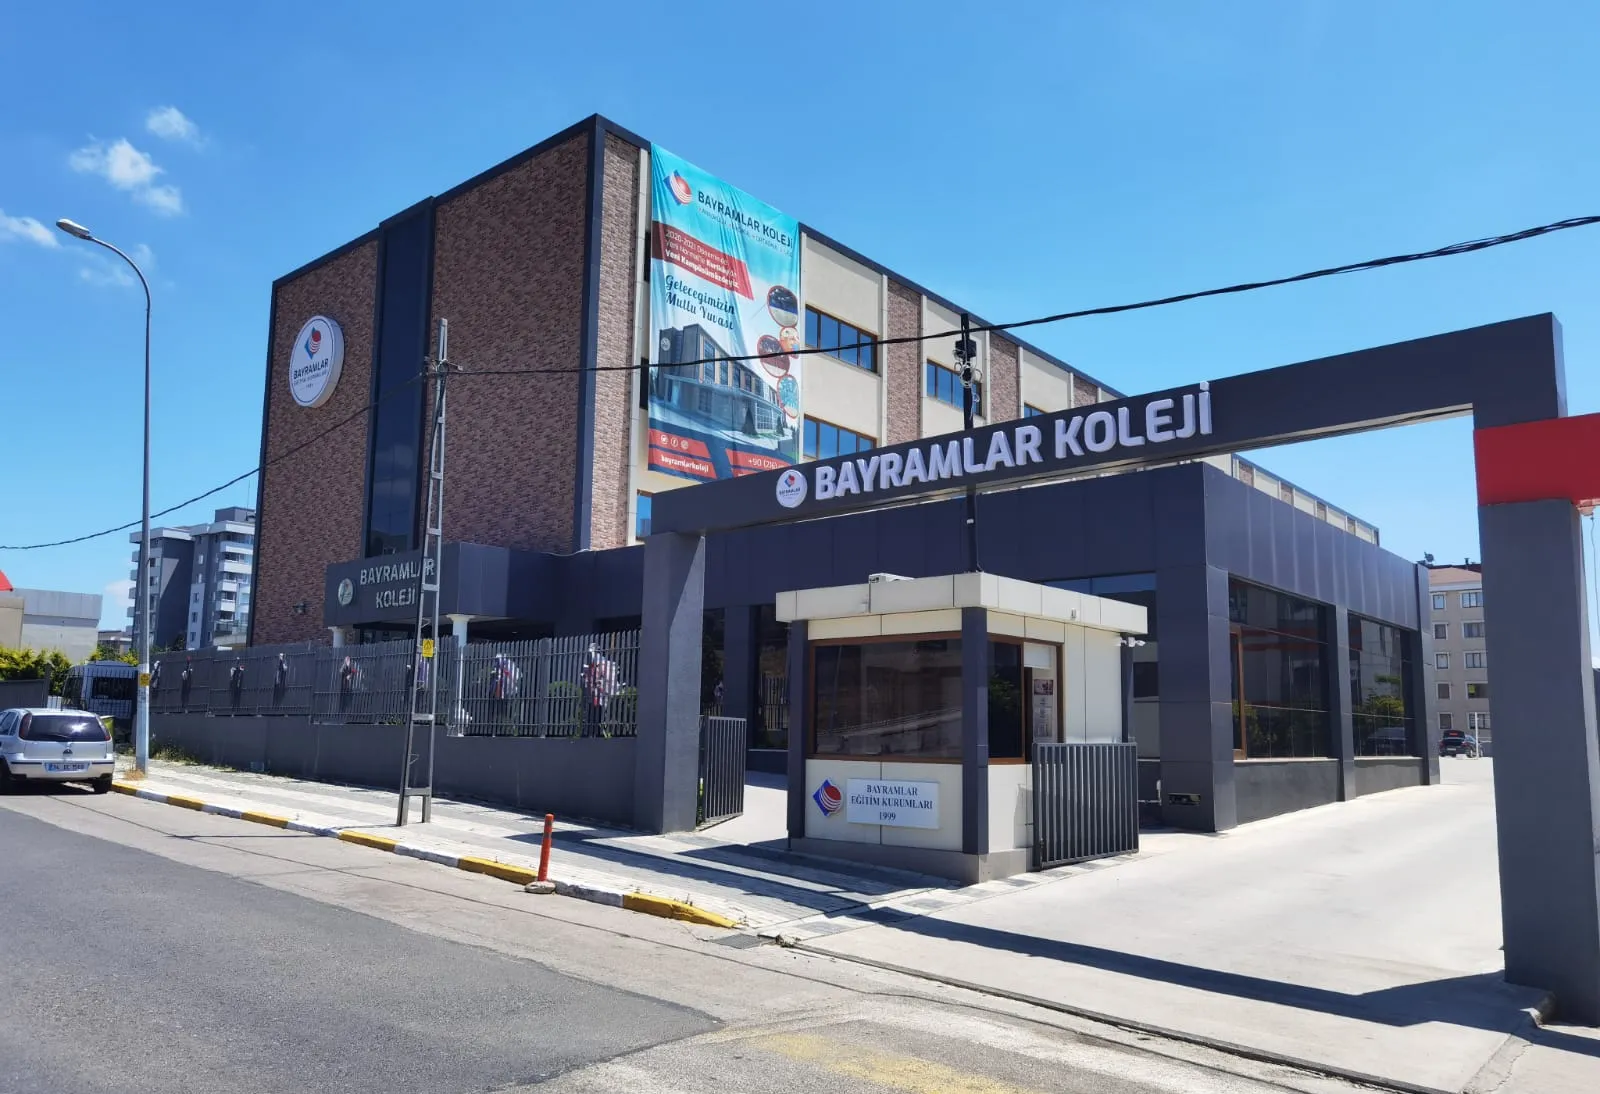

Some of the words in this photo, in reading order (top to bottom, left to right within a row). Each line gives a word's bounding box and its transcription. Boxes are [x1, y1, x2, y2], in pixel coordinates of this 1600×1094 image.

[698, 191, 760, 232] BAYRAMLAR
[763, 224, 793, 249] KOLEJİ
[665, 249, 680, 261] Yeni
[293, 358, 329, 380] BAYRAMLAR
[815, 425, 1043, 500] BAYRAMLAR
[1055, 382, 1213, 459] KOLEJİ
[375, 583, 416, 609] KOLEJİ
[866, 784, 918, 796] BAYRAMLAR
[851, 795, 880, 805] EĞİTİM
[881, 798, 933, 810] KURUMLARI
[879, 811, 896, 821] 1999
